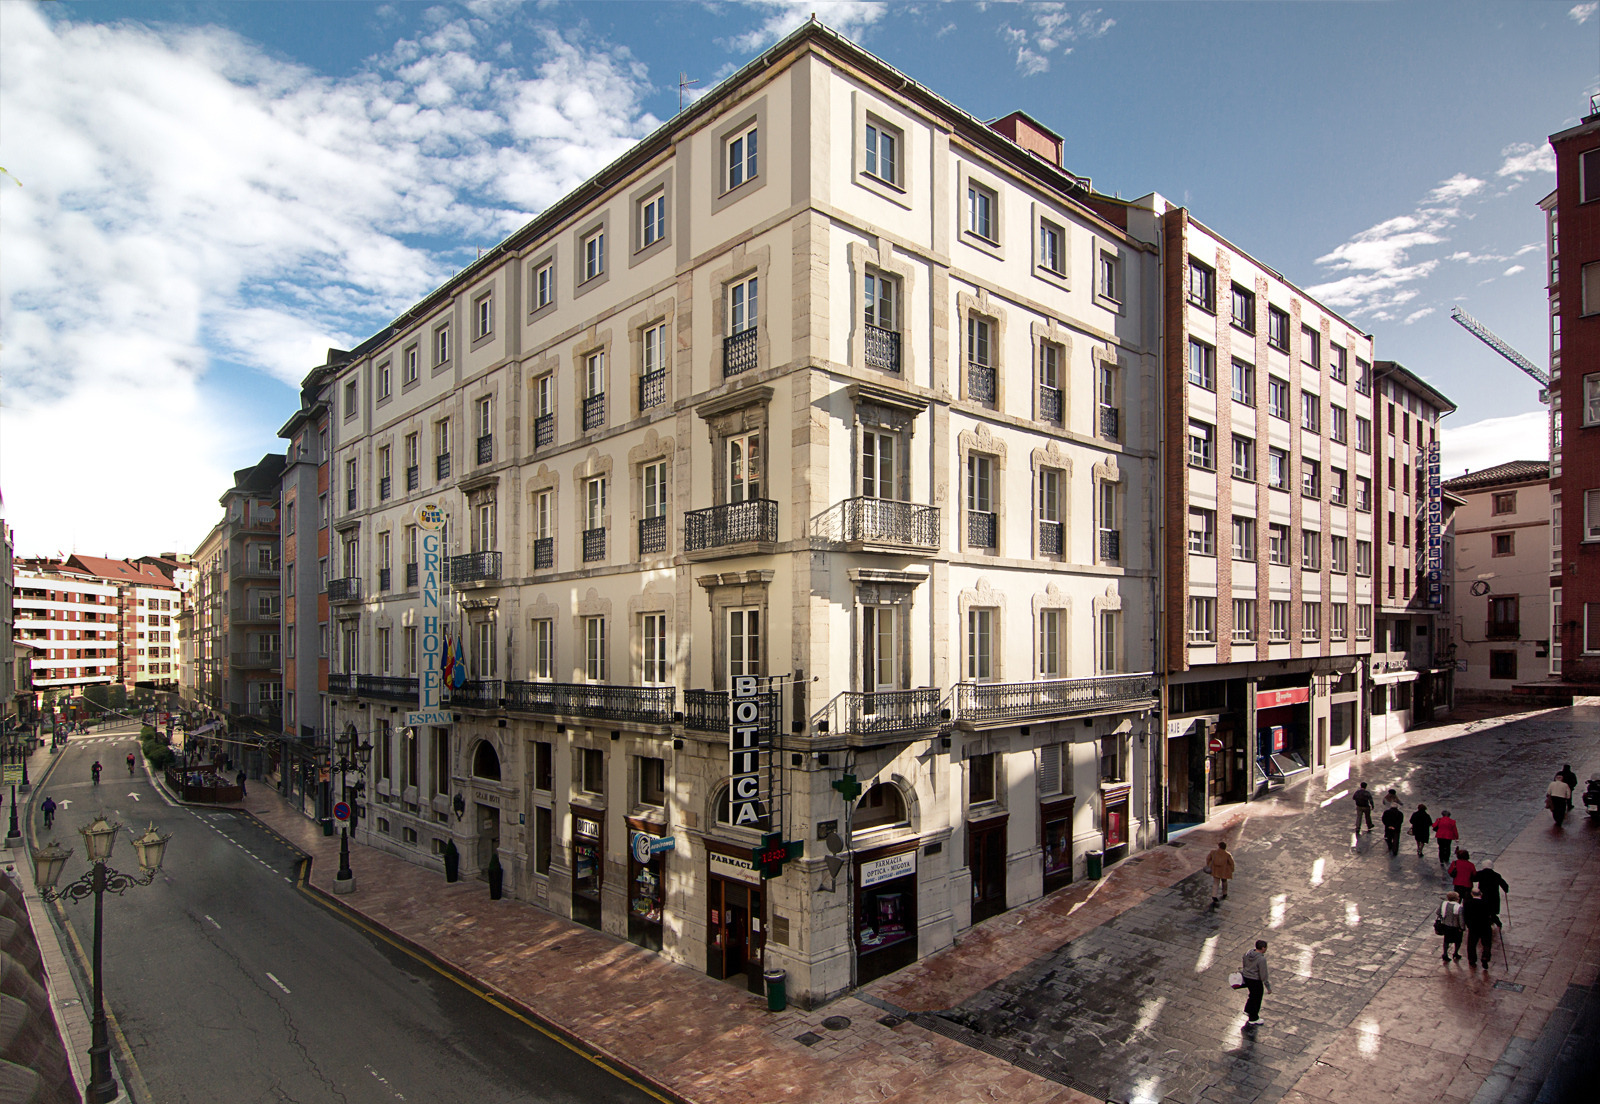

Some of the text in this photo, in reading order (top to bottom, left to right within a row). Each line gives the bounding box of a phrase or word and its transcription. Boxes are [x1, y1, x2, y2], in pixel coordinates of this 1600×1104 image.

[1429, 442, 1440, 592] HOTEL OVETENSE
[423, 535, 439, 708] GRAN HOTEL
[409, 711, 453, 725] ESPAÑA
[736, 676, 759, 826] BOTICA
[489, 794, 500, 804] HOTE
[577, 819, 598, 836] BOTICA
[711, 853, 754, 870] FARMACI
[866, 861, 910, 877] OPTICA MIGOYA
[875, 856, 902, 868] FARMACIA
